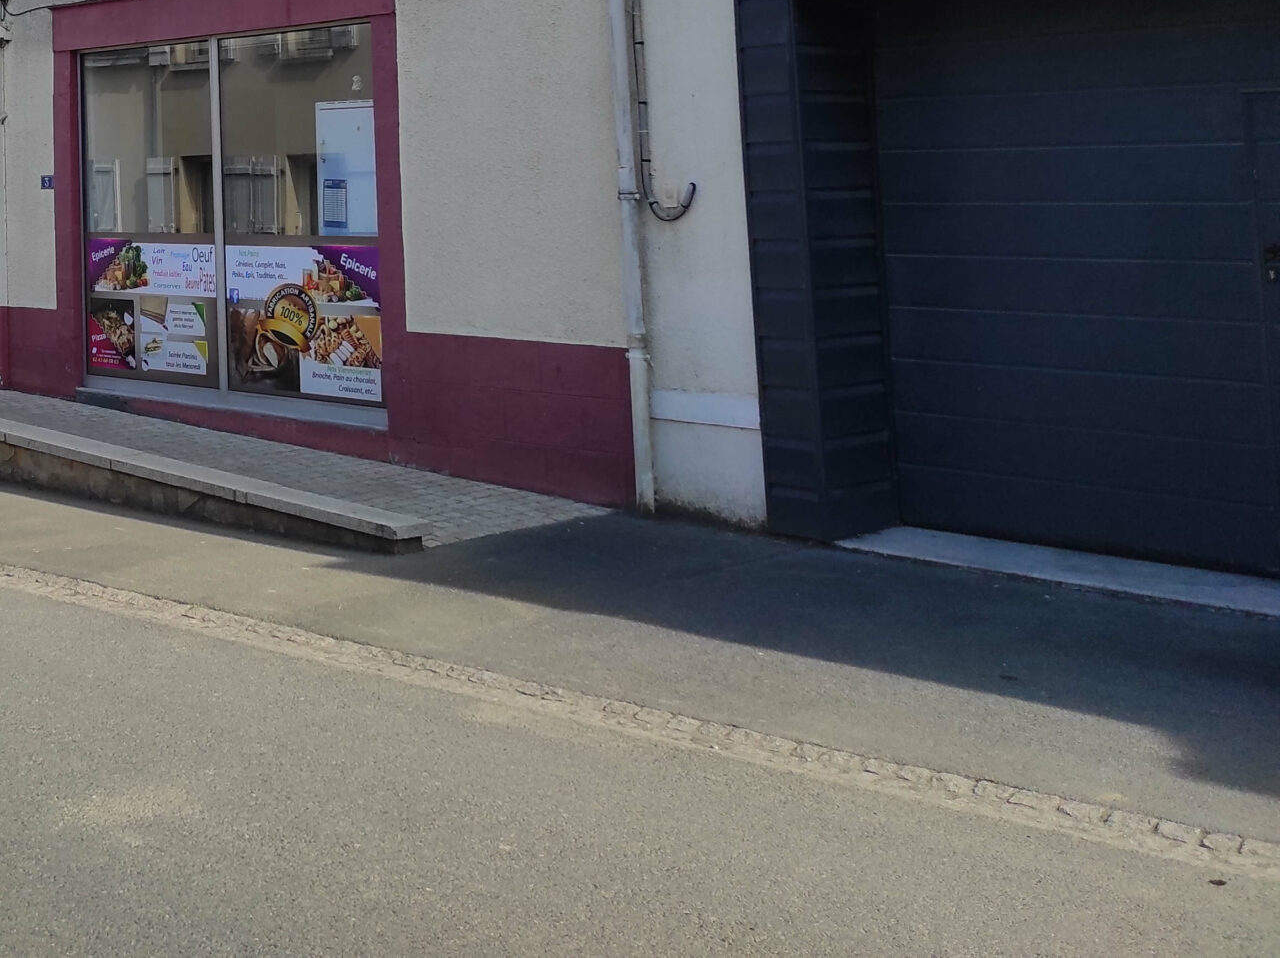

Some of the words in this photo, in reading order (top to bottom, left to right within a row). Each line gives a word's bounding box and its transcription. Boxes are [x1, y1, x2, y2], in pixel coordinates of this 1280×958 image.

[44, 178, 50, 187] 3
[91, 246, 115, 262] Epicerie
[151, 256, 163, 265] Vin
[192, 246, 214, 263] Oeuf
[182, 261, 193, 272] Eau
[340, 253, 377, 280] Epicerie
[267, 287, 299, 317] FABRICATION
[300, 293, 316, 338] ARTISANALE
[280, 305, 304, 327] 100%
[91, 333, 107, 342] Pizza
[333, 373, 345, 382] Pain
